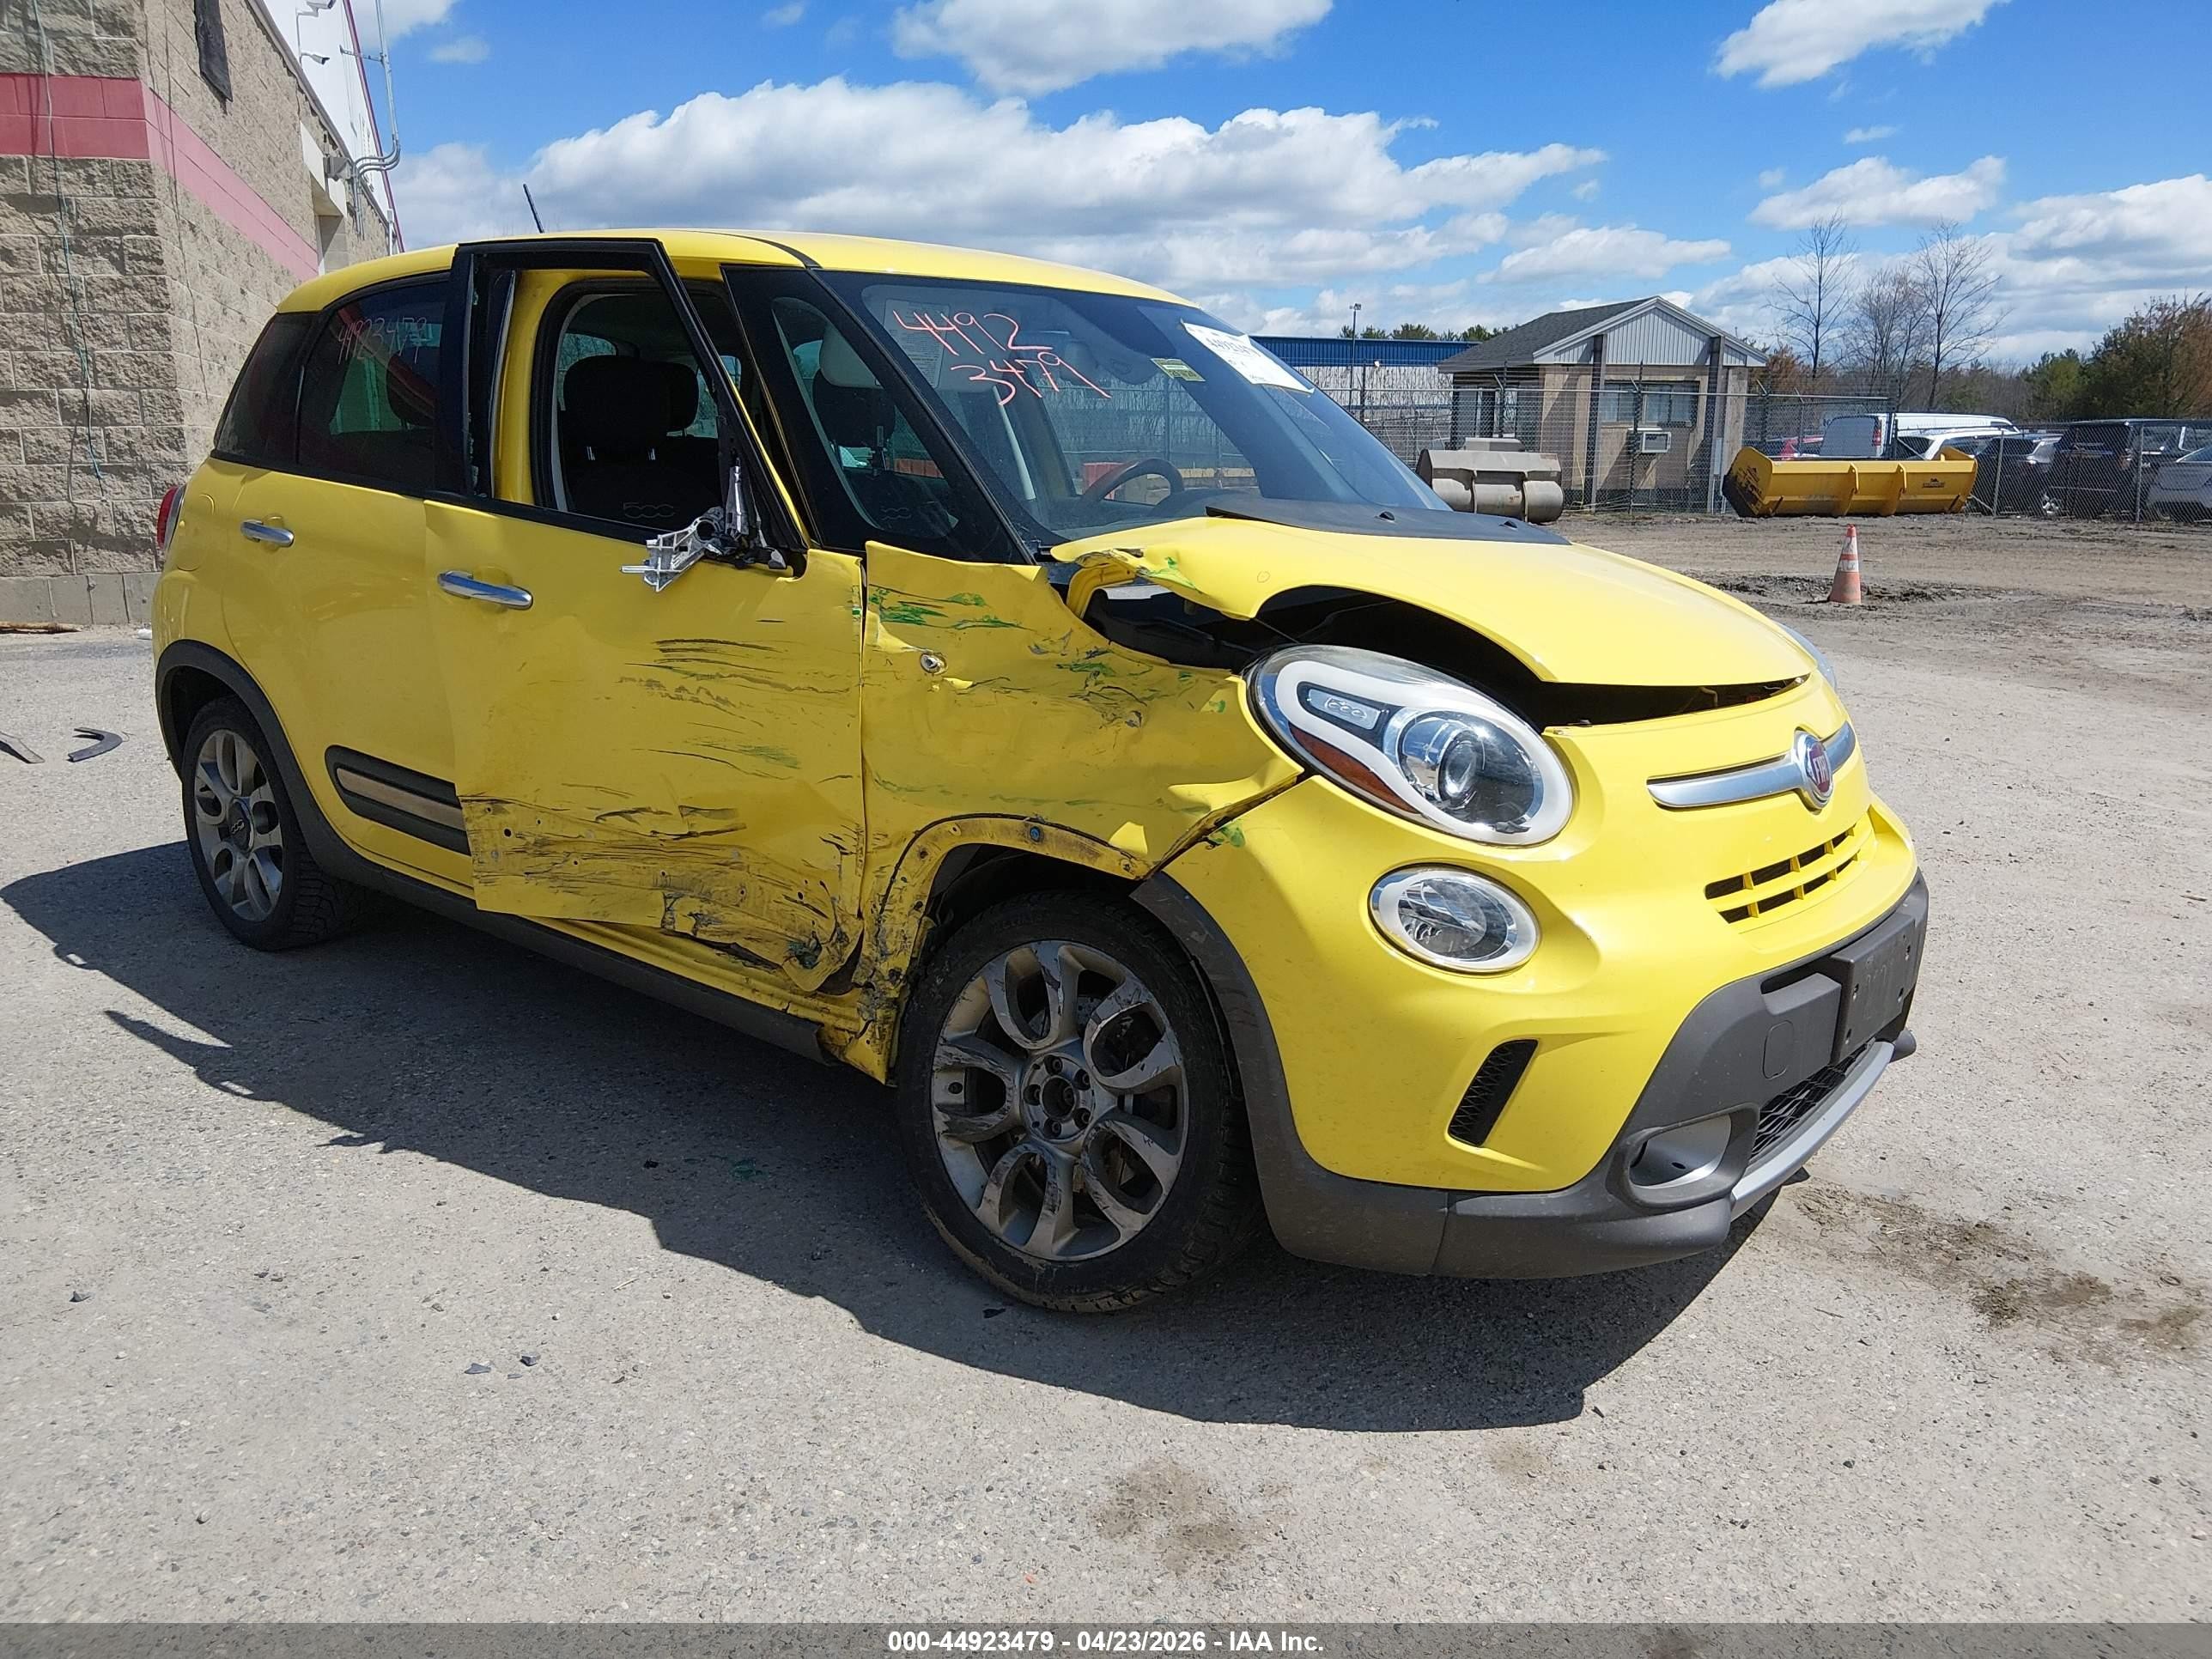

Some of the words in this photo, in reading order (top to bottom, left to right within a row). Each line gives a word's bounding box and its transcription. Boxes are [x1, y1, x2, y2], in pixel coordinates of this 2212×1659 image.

[892, 310, 1054, 356] 4492
[951, 351, 1112, 406] 3479
[1812, 755, 1830, 784] FIA
